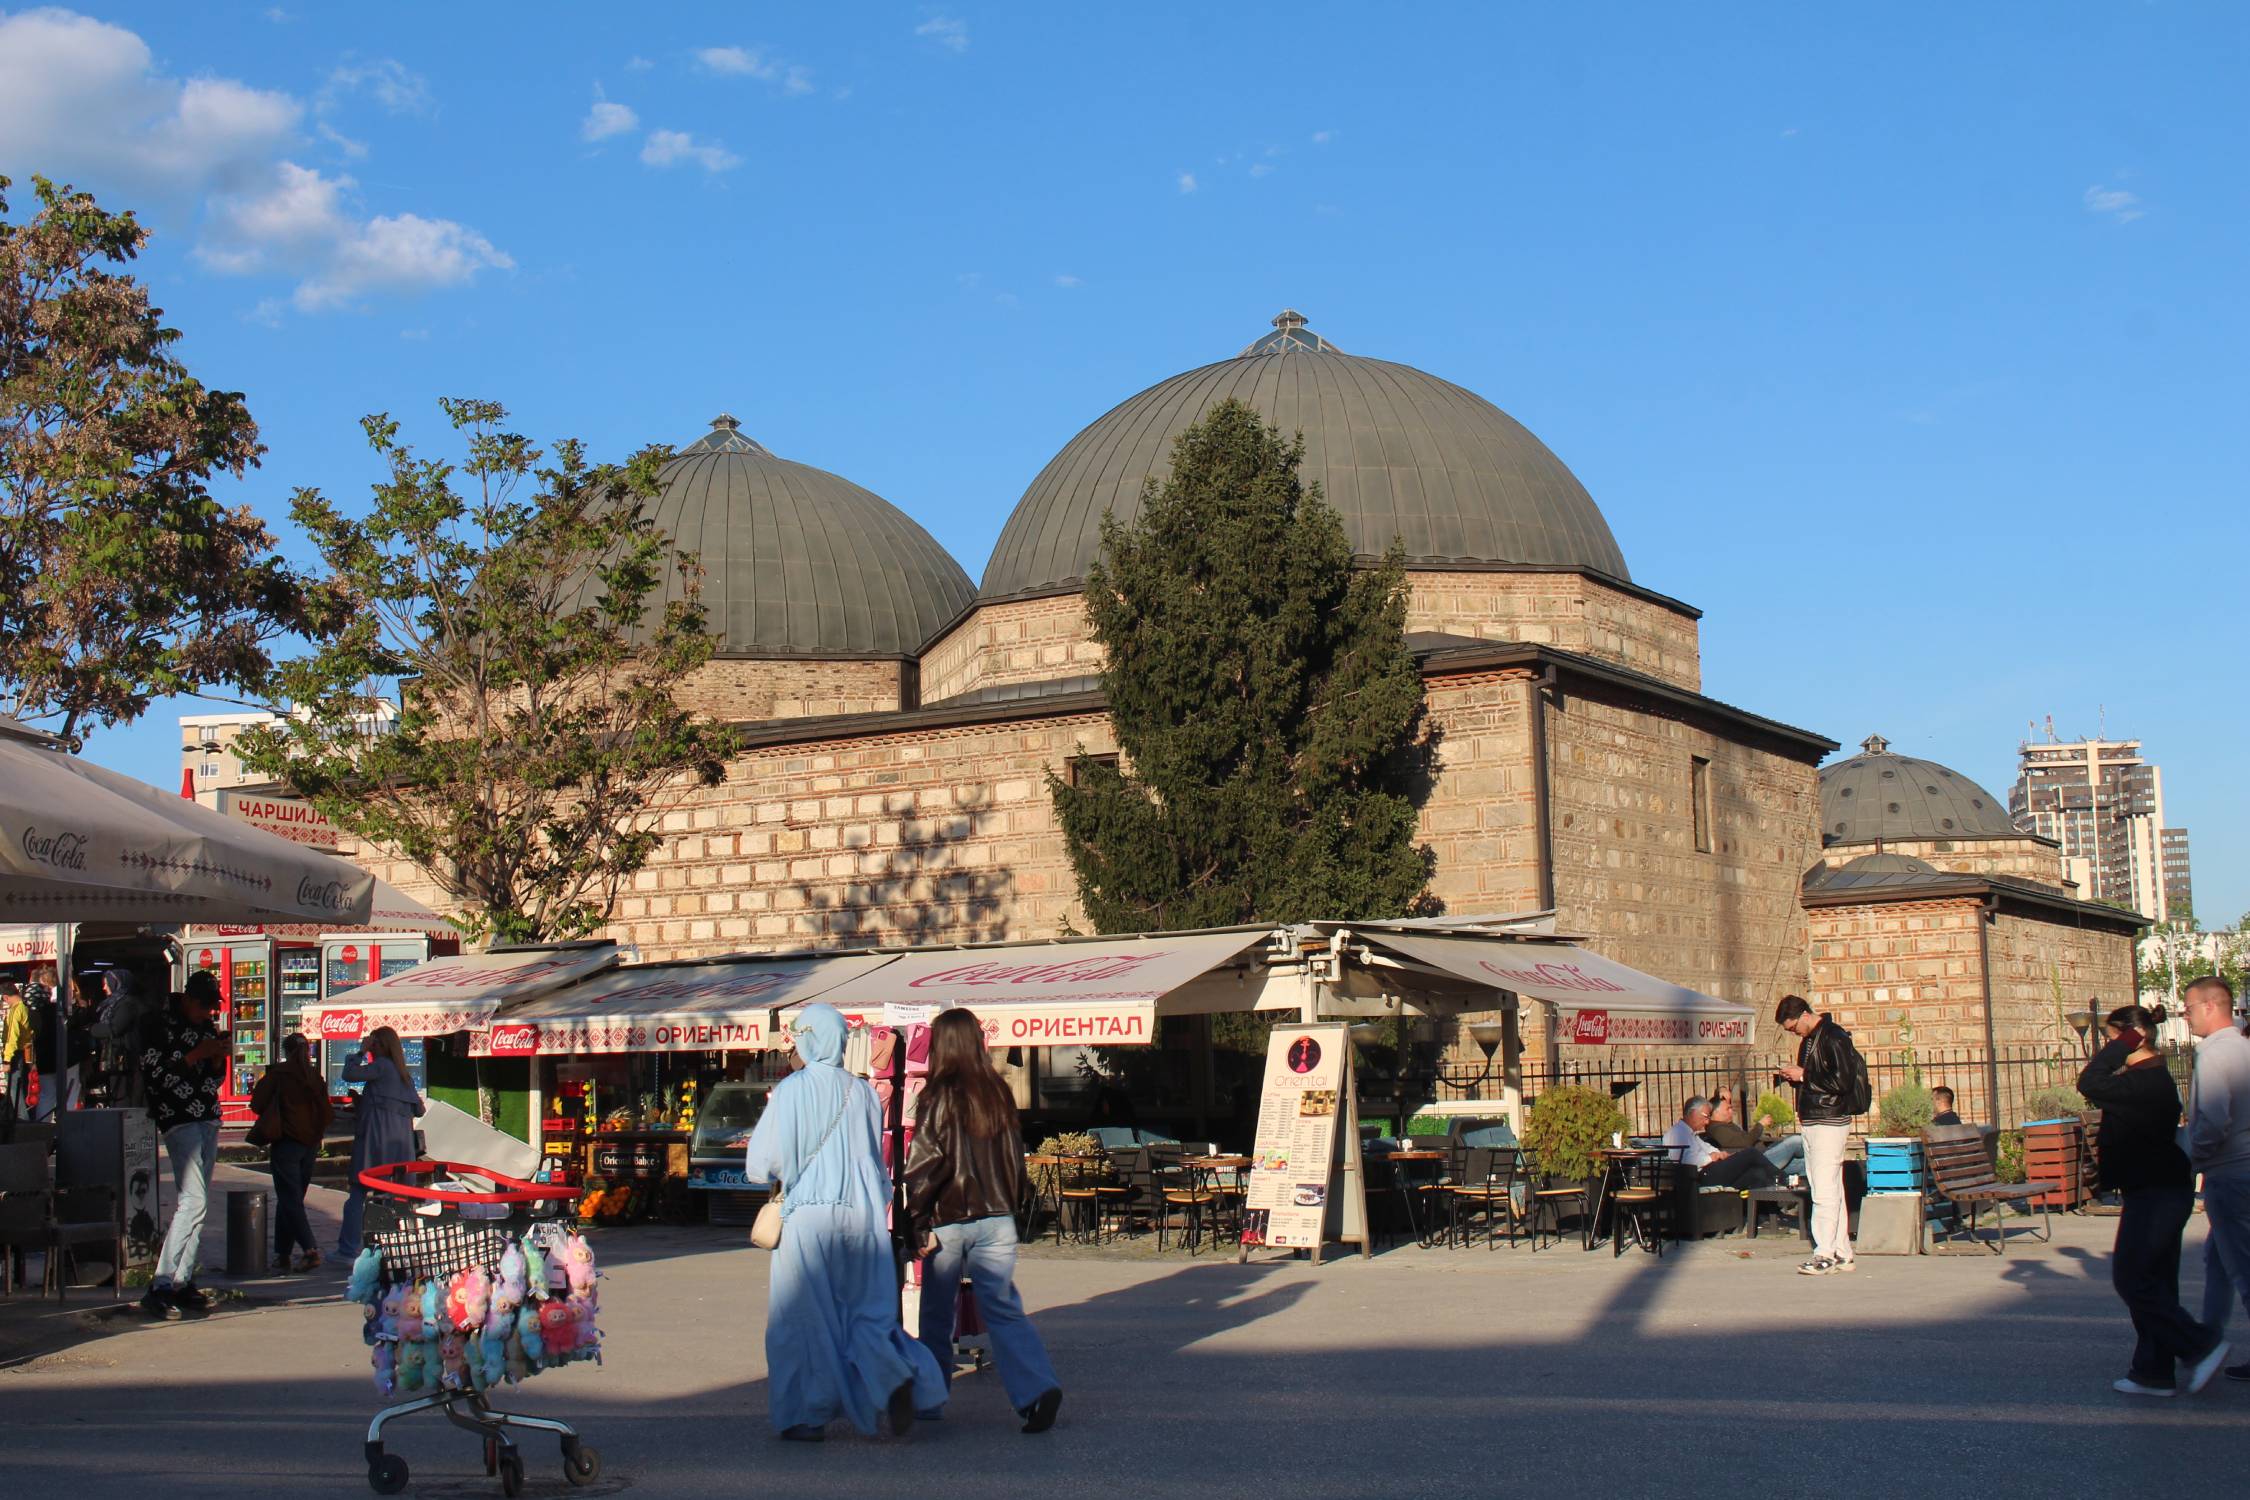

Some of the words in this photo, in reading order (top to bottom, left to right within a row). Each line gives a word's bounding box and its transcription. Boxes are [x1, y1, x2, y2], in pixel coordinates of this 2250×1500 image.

[239, 800, 329, 825] ЧАРШИЈА
[322, 1013, 363, 1033] Coca-Cola
[1012, 1016, 1143, 1037] ОРИЕНТАЛ
[1699, 1020, 1748, 1038] ОРИЕНТАЛ
[492, 1027, 537, 1050] Coca-Cola
[656, 1024, 760, 1044] ОРИЕНТАЛ
[720, 1171, 737, 1184] Ice
